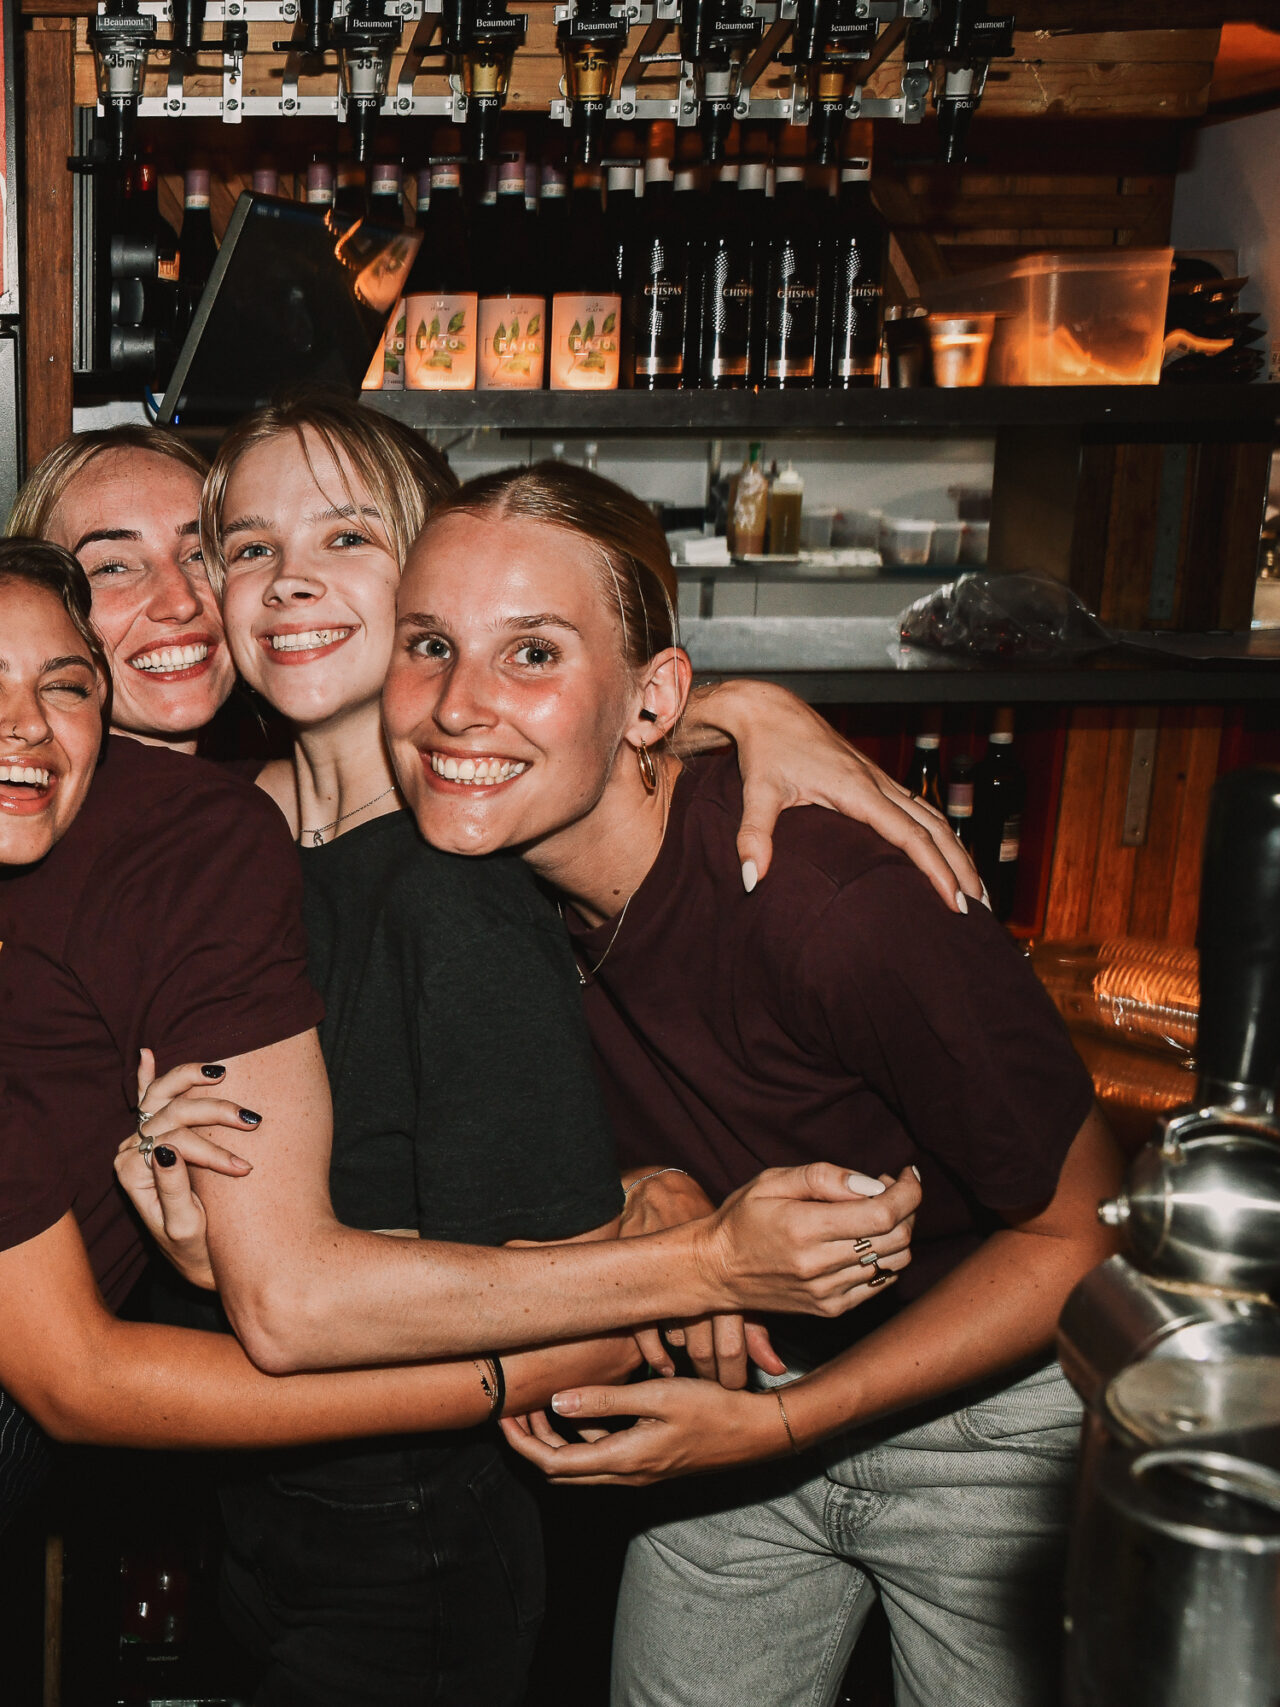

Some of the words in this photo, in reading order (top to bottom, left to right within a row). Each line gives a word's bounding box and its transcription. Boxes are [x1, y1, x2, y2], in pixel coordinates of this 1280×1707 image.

[103, 17, 144, 26] Beaumont
[353, 19, 393, 28] Beaumont
[476, 18, 516, 27] Beaumont
[715, 21, 754, 30] Beaumont
[974, 21, 1005, 30] eaumont
[577, 22, 618, 31] Beaumont
[357, 99, 376, 107] SOLO
[478, 99, 498, 107] SOLO
[584, 103, 603, 111] SOLO
[712, 103, 731, 111] SOLO
[644, 287, 682, 296] CHISPAS
[389, 340, 405, 350] JO
